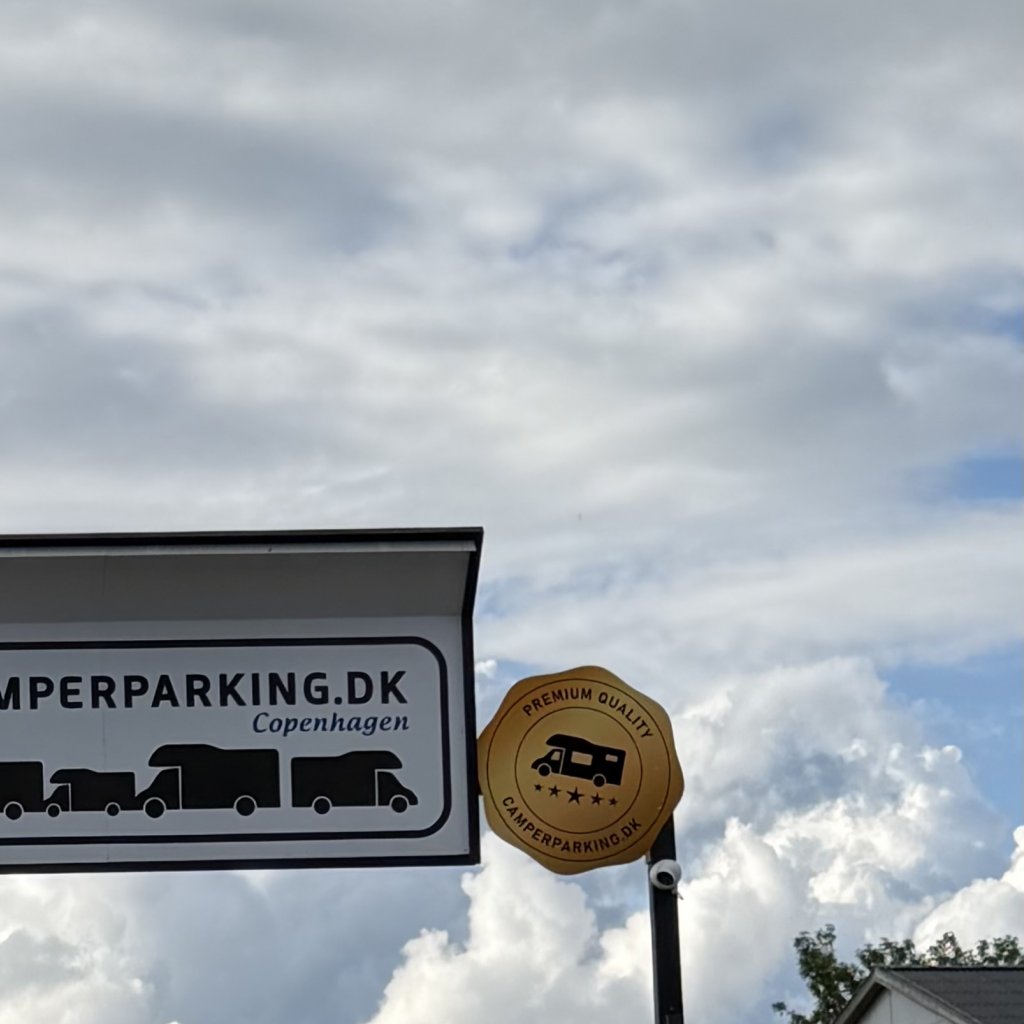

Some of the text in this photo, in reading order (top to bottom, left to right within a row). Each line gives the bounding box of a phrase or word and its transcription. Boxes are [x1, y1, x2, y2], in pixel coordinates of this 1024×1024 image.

[252, 711, 410, 737] Copenhagen
[523, 688, 654, 739] PREMIUM QUALITY
[502, 796, 642, 854] CAMPERPARKING.DK
